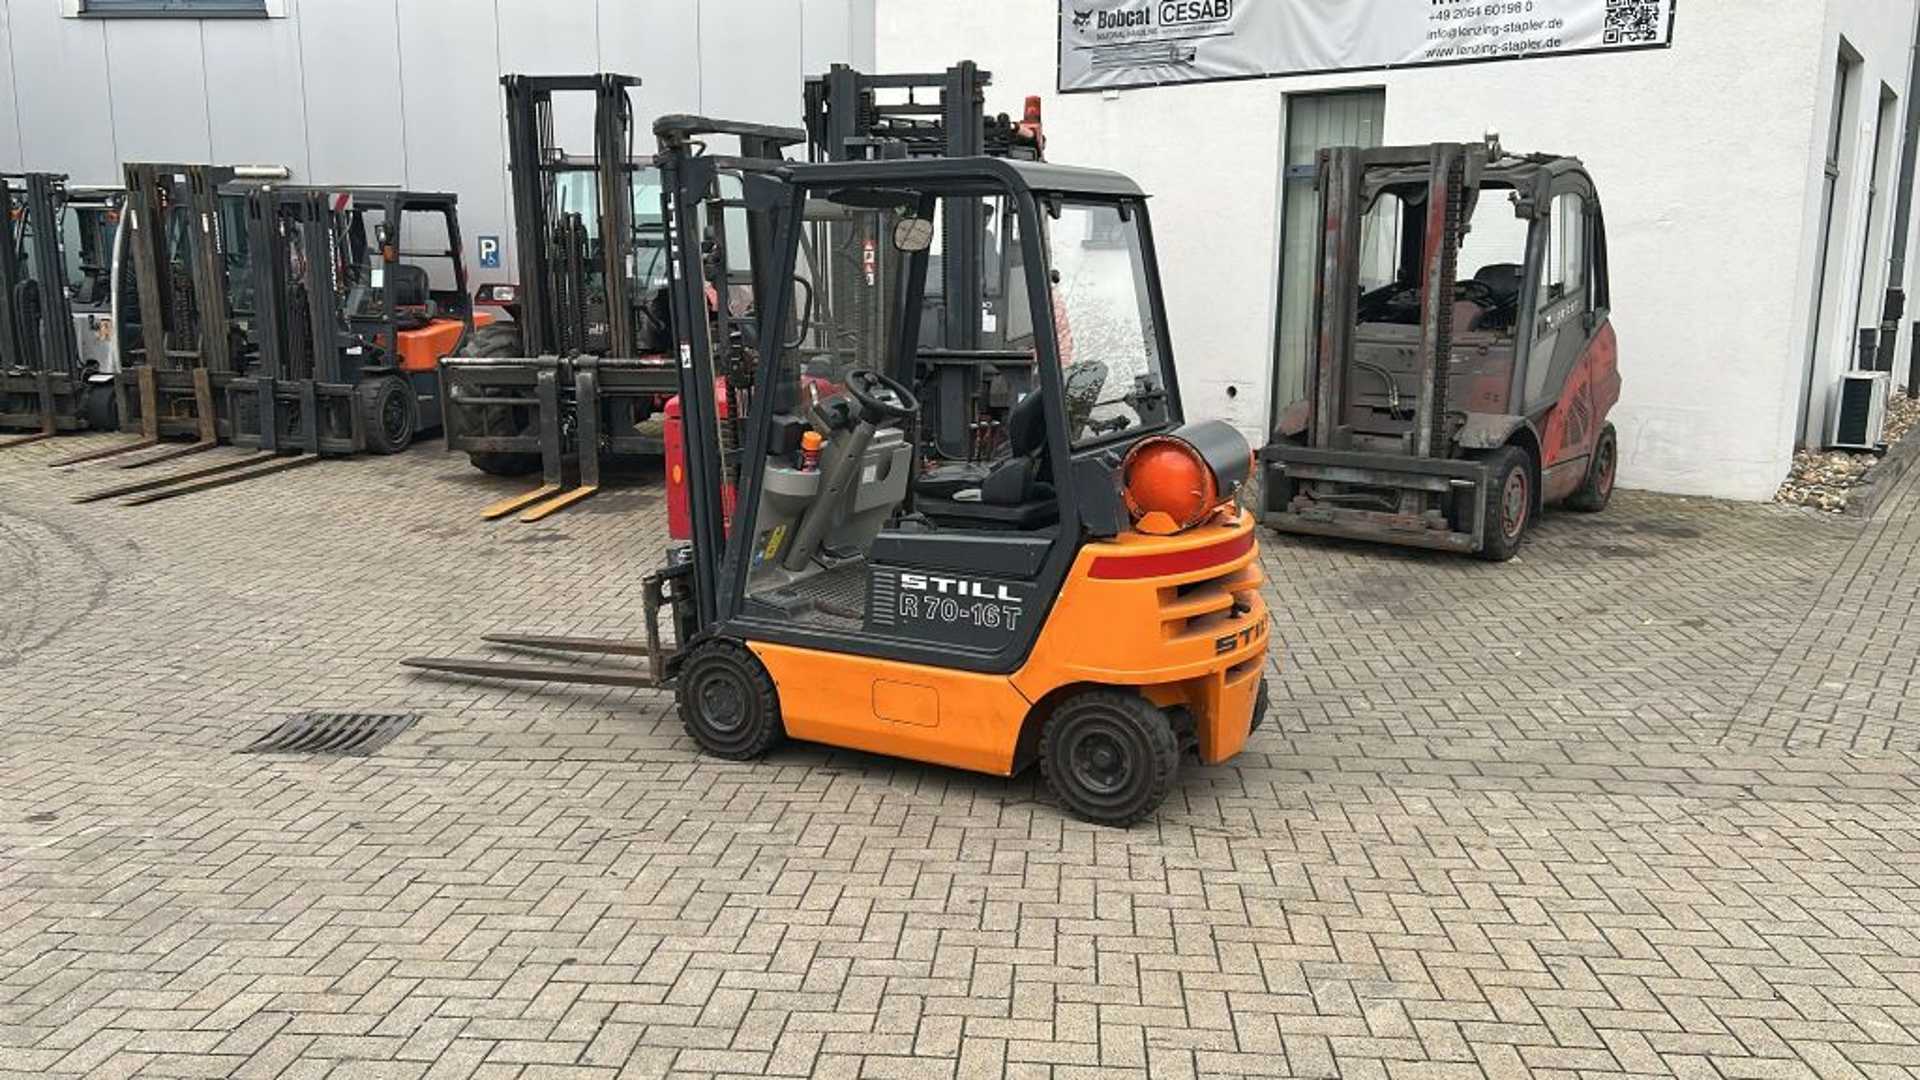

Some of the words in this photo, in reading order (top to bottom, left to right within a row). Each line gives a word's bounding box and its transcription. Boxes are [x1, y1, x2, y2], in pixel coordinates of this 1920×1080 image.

[1097, 7, 1150, 29] Bobcat
[1162, 1, 1229, 22] CESAB
[481, 240, 497, 260] P
[901, 573, 1023, 603] STILL
[899, 592, 918, 618] R
